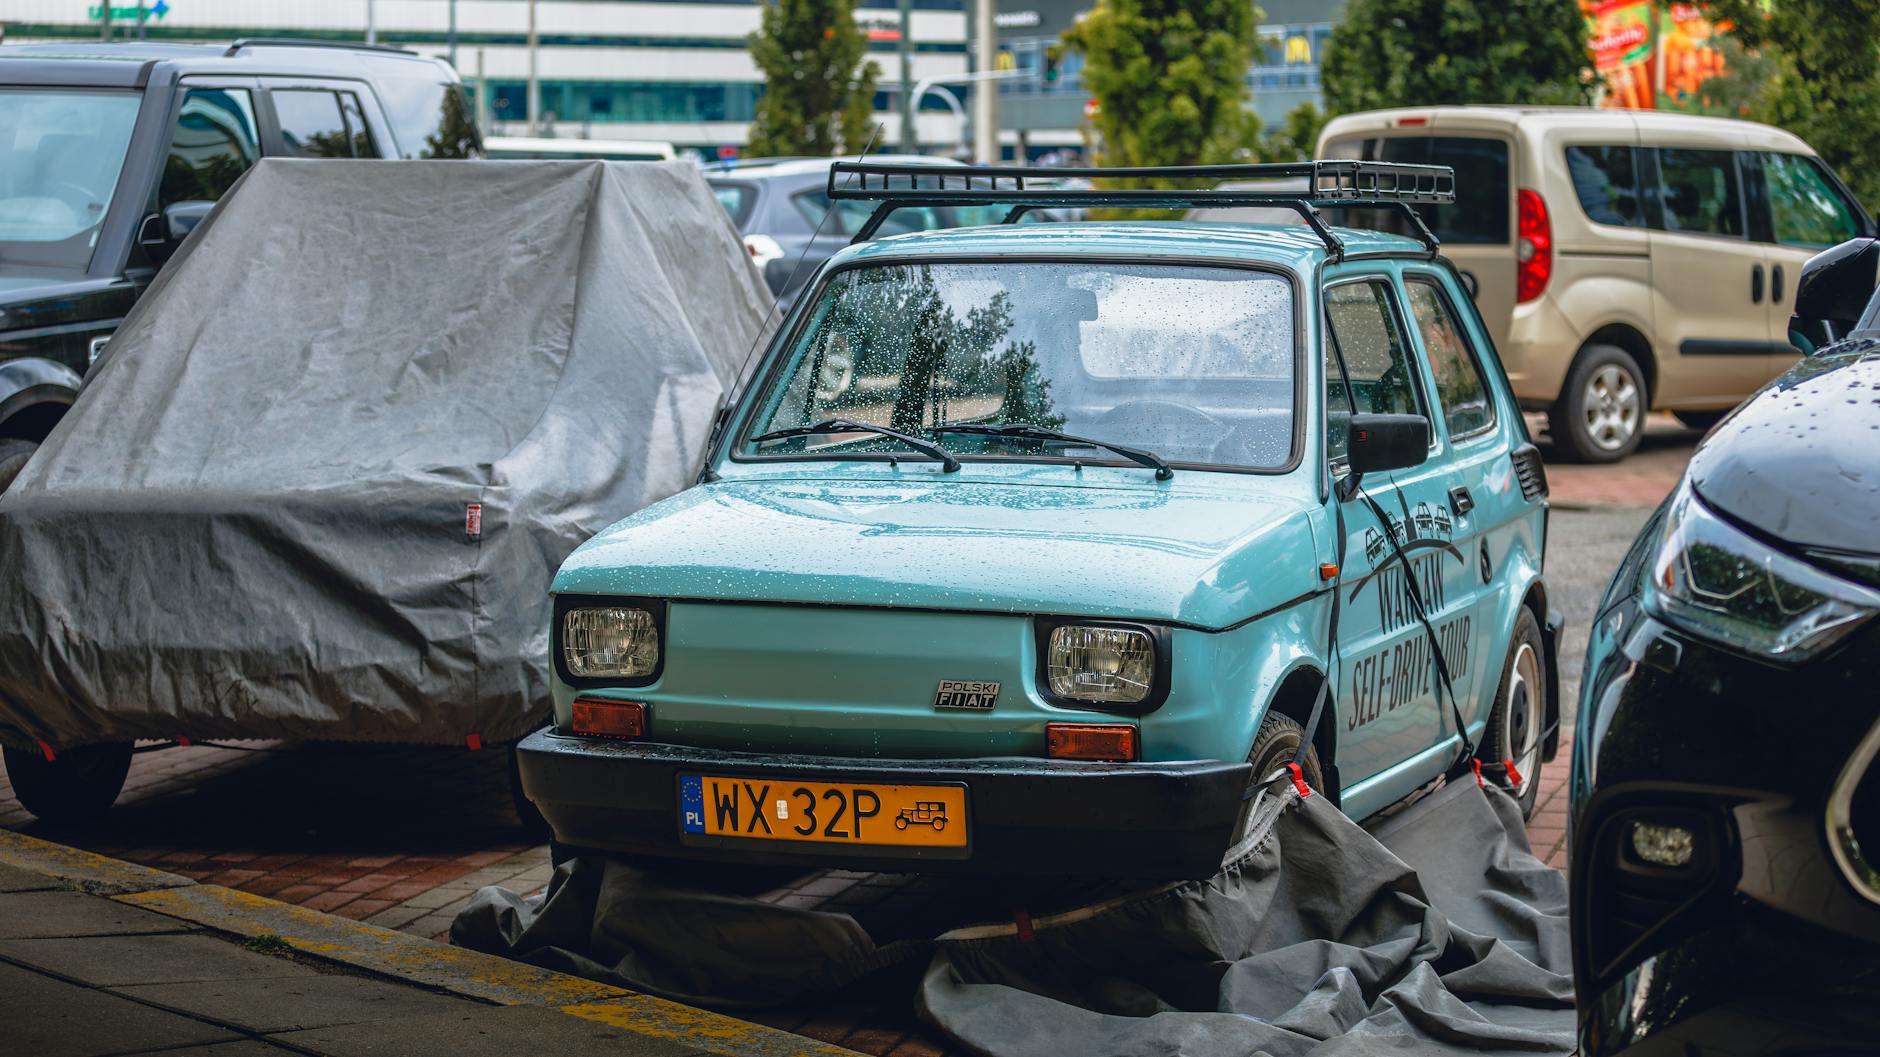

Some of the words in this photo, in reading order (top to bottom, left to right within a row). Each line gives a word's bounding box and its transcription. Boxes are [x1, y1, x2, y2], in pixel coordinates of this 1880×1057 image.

[1348, 631, 1432, 732] SELF-DRIVE
[1437, 616, 1471, 688] TOUR
[941, 682, 997, 693] POLSKI
[938, 692, 995, 707] FIAT
[712, 782, 774, 834] WX
[791, 787, 881, 838] 32P
[685, 811, 703, 826] PL
